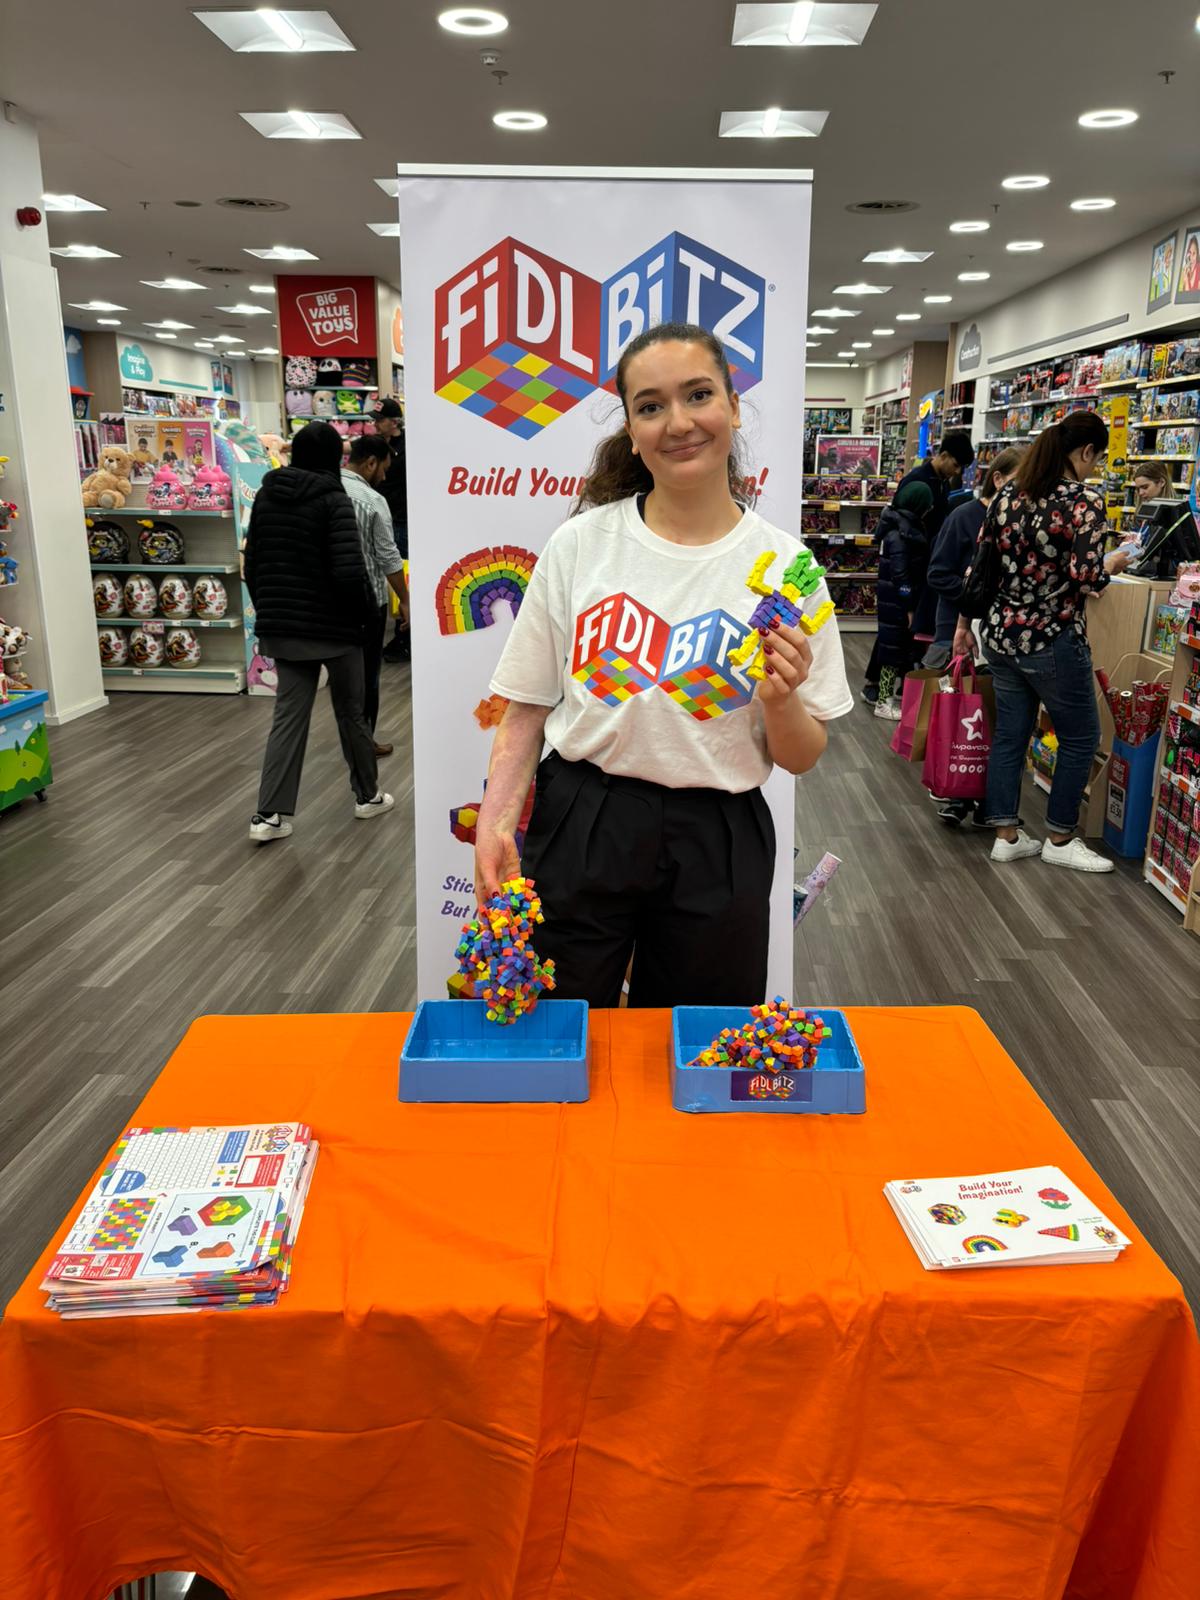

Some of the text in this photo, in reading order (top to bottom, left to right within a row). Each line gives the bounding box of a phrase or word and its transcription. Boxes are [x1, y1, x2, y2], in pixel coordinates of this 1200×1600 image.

[315, 292, 338, 307] BIG
[308, 304, 350, 320] VALUE
[311, 316, 354, 336] TOYS
[448, 467, 588, 497] Build Your
[441, 900, 470, 918] But
[958, 1182, 987, 1191] Build
[958, 1185, 1023, 1200] Imagination!
